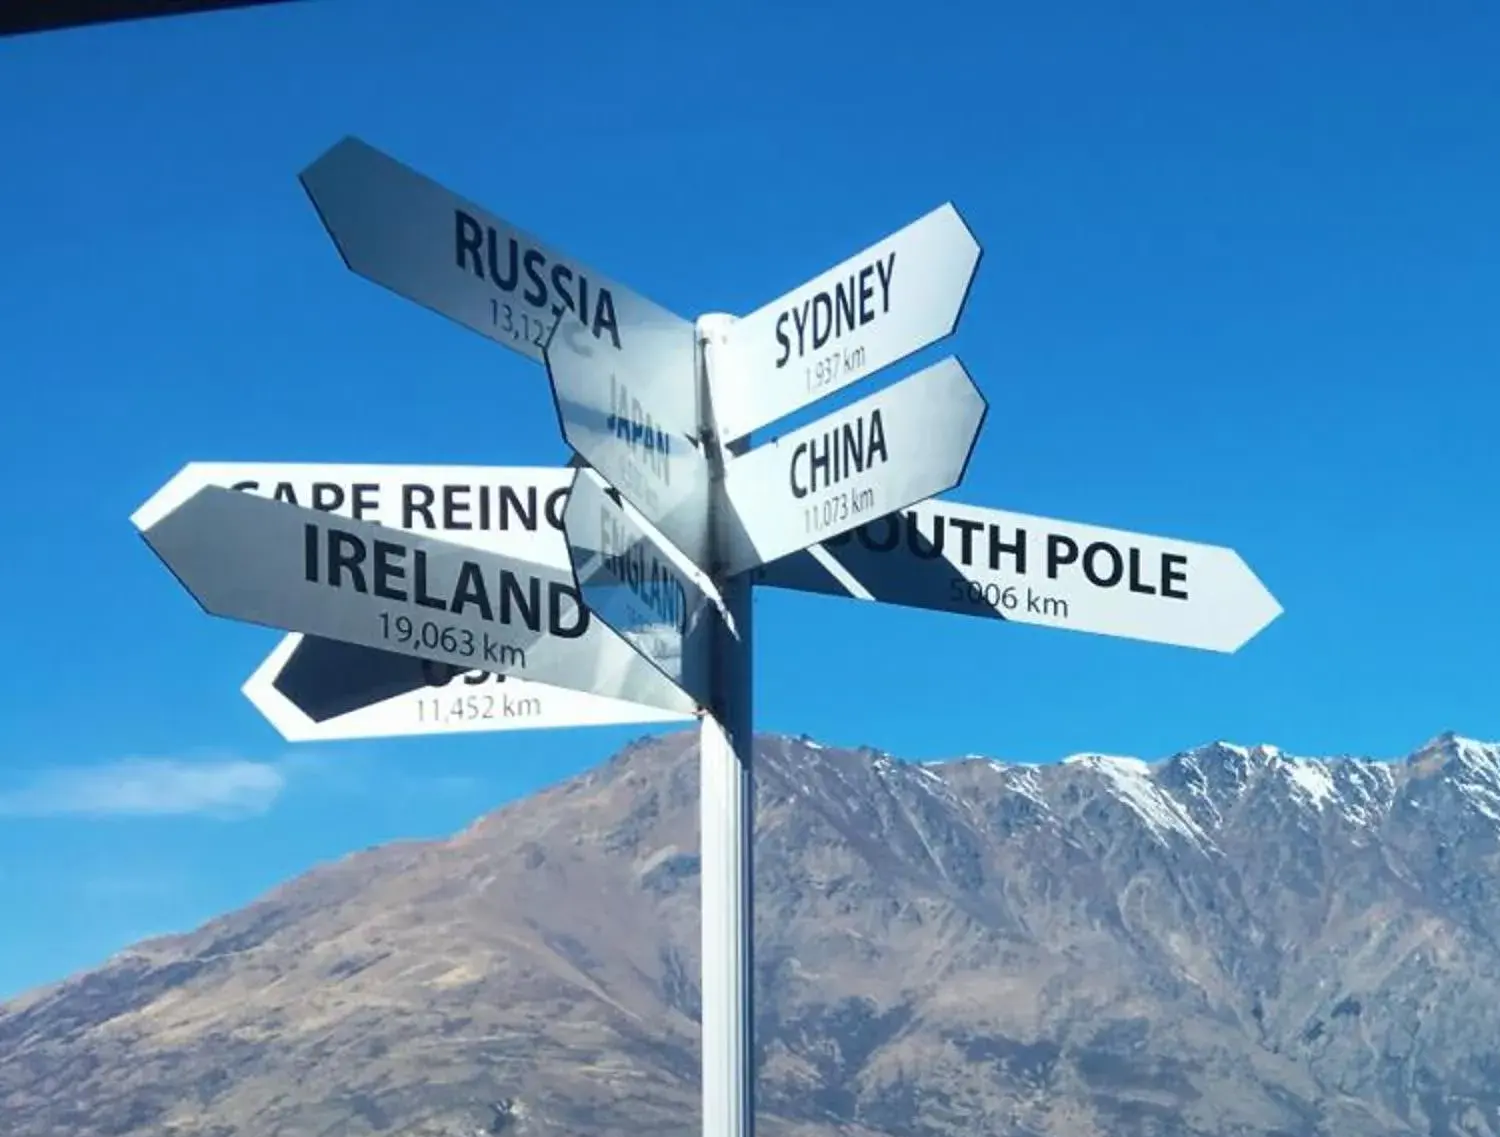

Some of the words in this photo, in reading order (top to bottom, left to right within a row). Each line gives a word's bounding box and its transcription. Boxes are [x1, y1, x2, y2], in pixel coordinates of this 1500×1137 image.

[455, 210, 622, 350] RUSSIA
[775, 251, 896, 369] SYDNEY
[489, 299, 552, 349] 13,12
[843, 345, 866, 374] km
[606, 373, 670, 488] JAPAN
[790, 408, 888, 499] CHINA
[851, 487, 875, 514] km
[305, 524, 590, 639] IRELAND
[830, 508, 1027, 575] OUTH
[1046, 533, 1189, 600] POLE
[950, 577, 1018, 610] 5006
[1027, 587, 1069, 618] km
[379, 612, 475, 658] 19,063
[483, 632, 527, 669] km
[416, 696, 495, 723] 11,452
[503, 693, 542, 718] km
